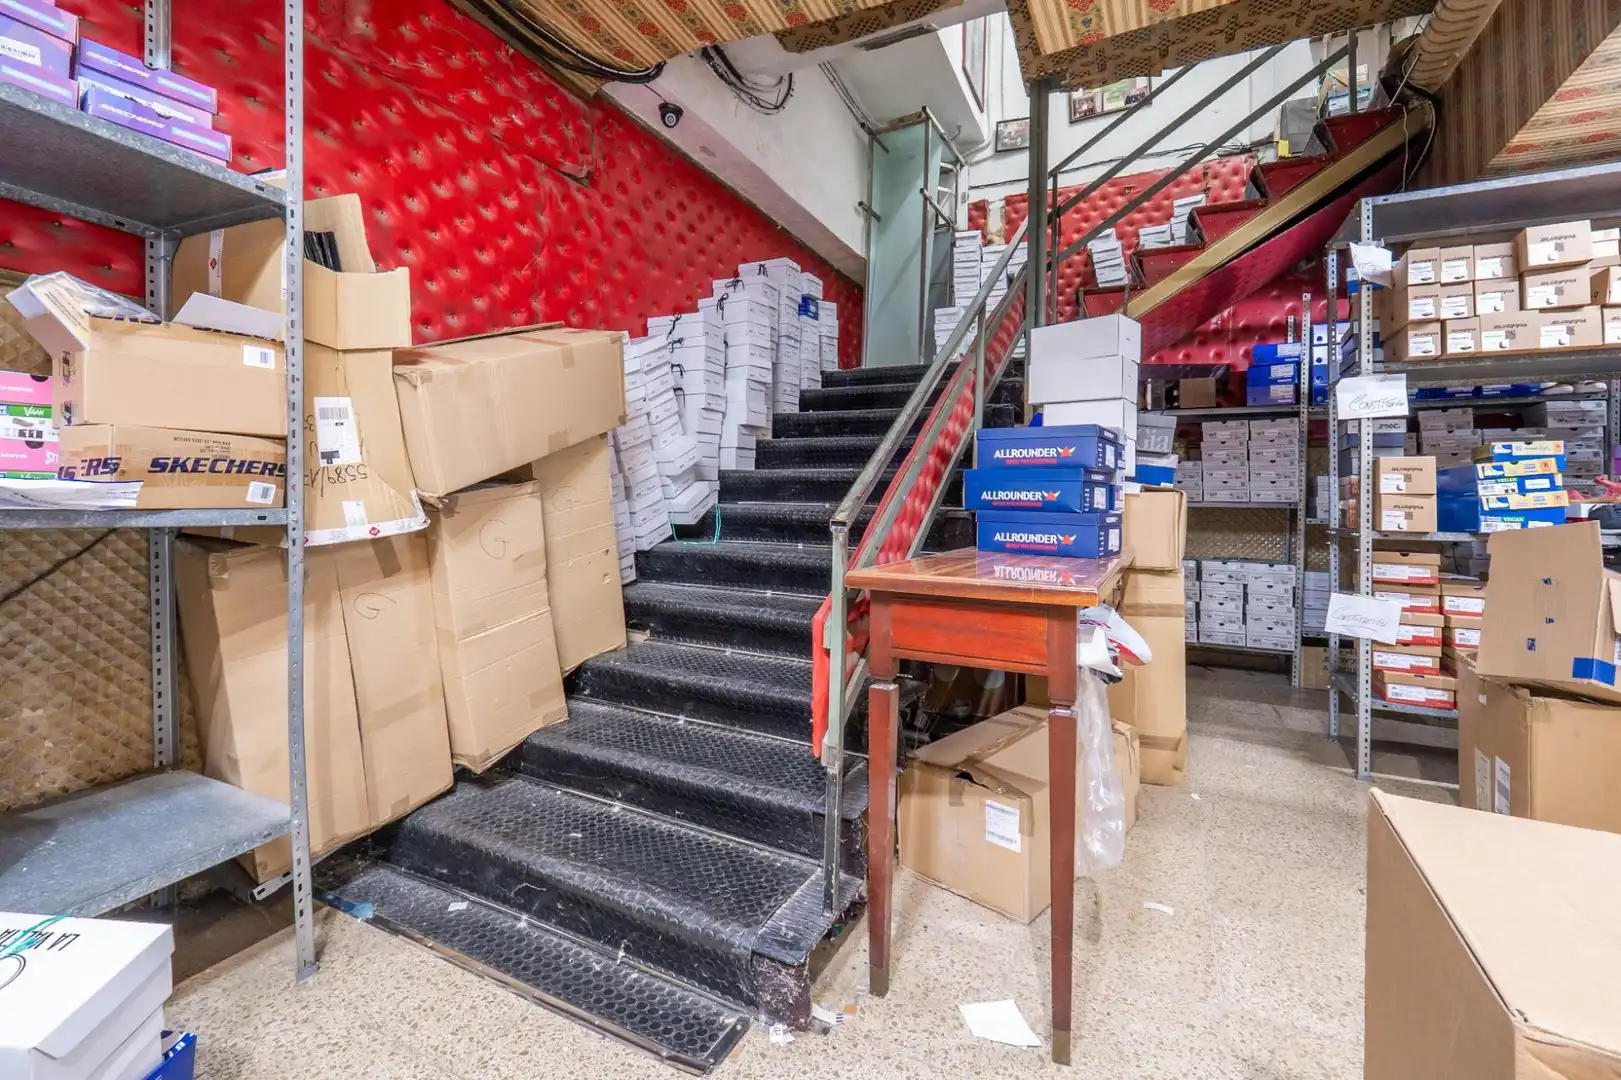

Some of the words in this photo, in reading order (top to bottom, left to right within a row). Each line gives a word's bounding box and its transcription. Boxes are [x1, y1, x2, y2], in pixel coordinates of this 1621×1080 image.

[994, 446, 1057, 459] ALLROUNDER
[981, 490, 1043, 501] ALLROUNDER
[478, 519, 513, 560] G
[994, 532, 1058, 545] ALLROUNDER
[353, 591, 398, 620] G
